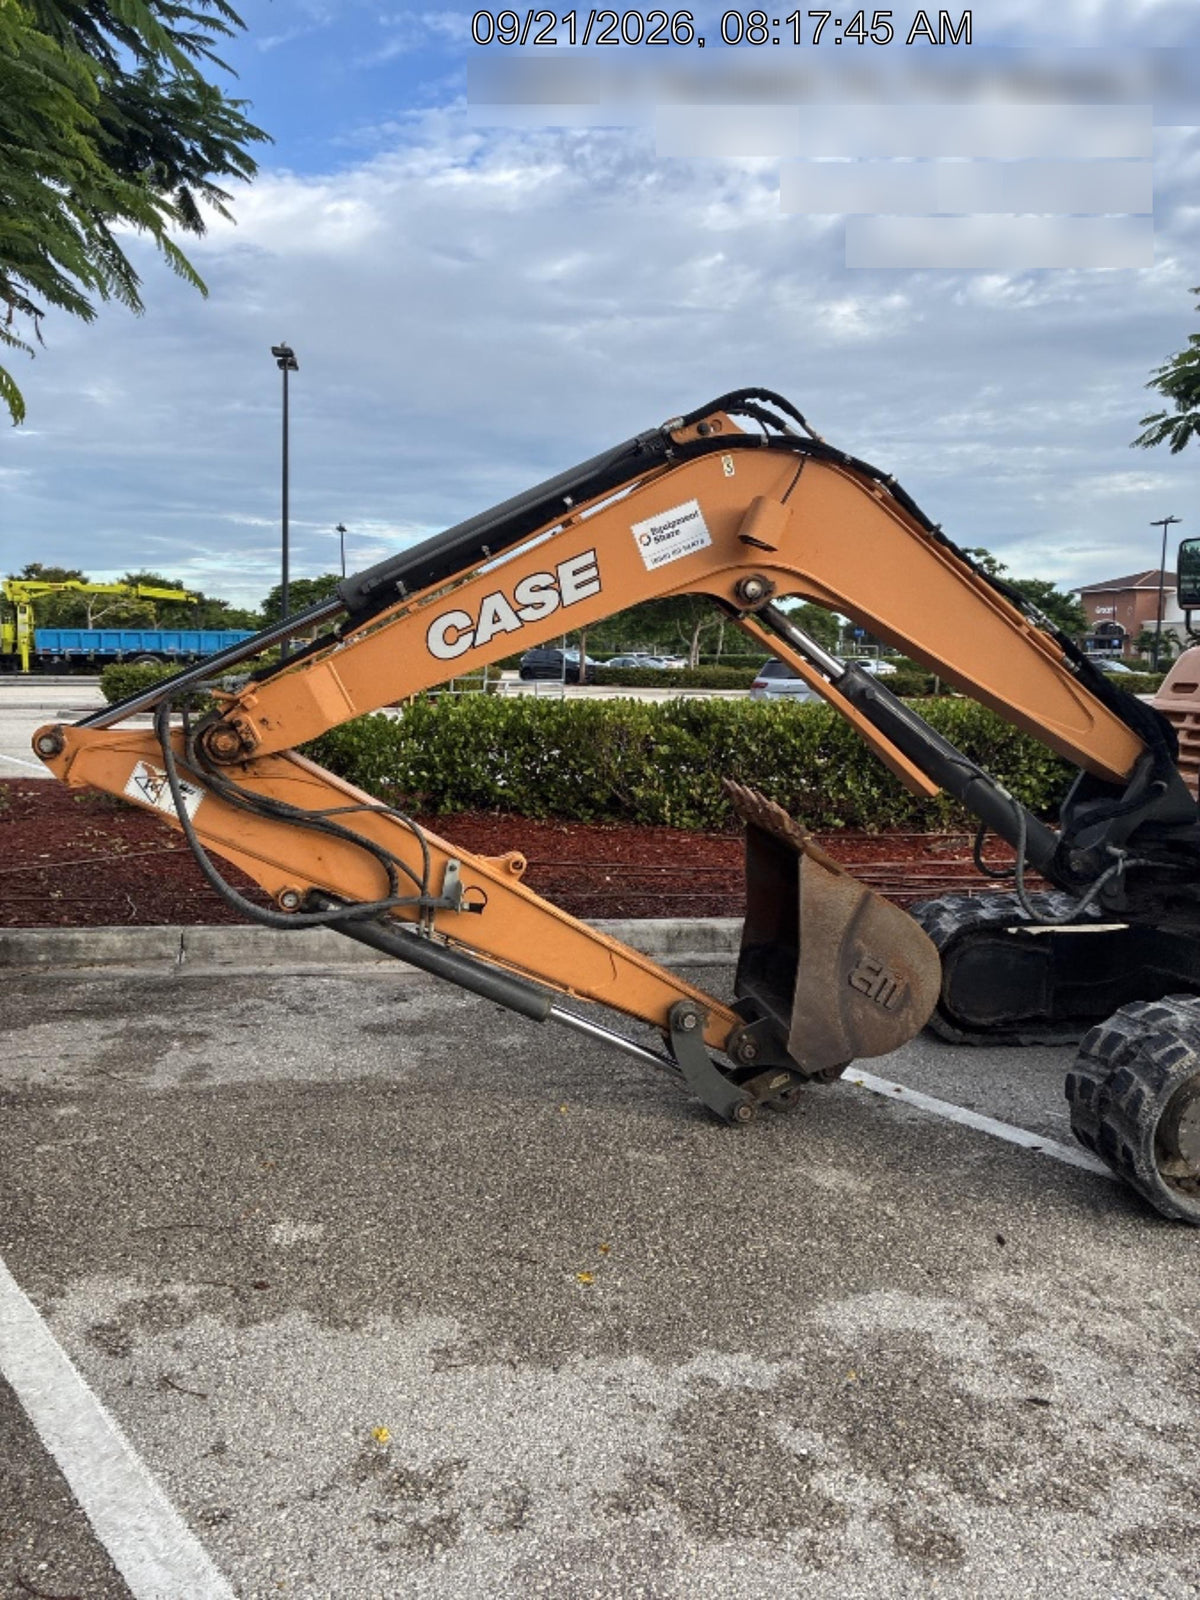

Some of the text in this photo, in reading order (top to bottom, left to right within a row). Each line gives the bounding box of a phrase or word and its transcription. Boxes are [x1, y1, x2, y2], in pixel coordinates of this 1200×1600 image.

[650, 509, 699, 536] Equipment
[653, 529, 681, 545] Share
[426, 547, 602, 660] CASE
